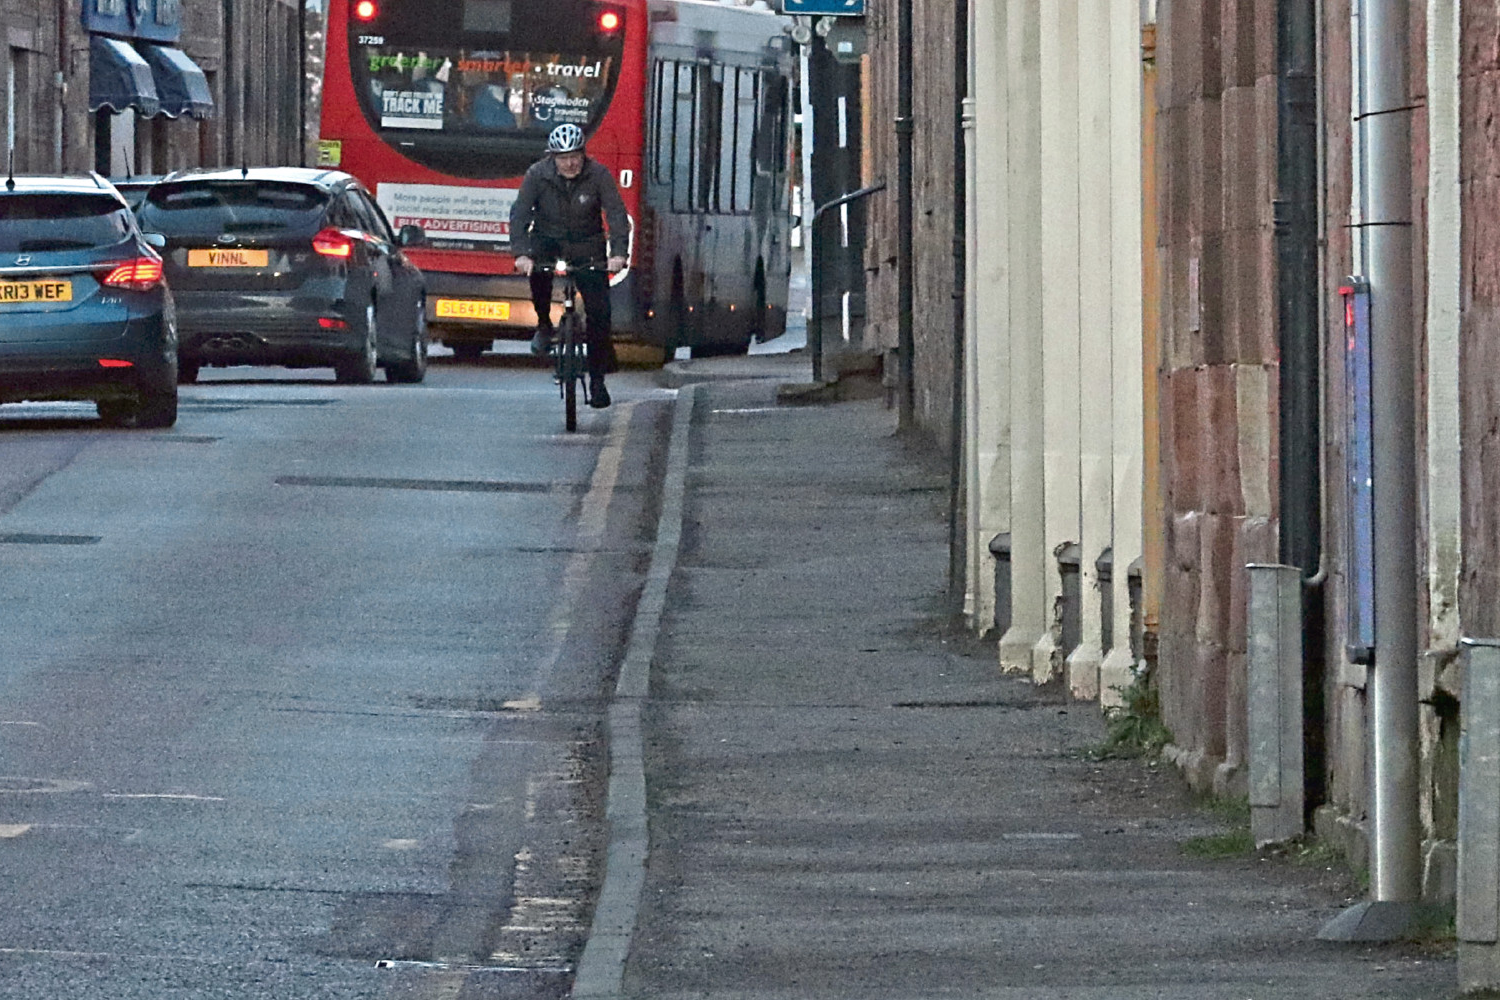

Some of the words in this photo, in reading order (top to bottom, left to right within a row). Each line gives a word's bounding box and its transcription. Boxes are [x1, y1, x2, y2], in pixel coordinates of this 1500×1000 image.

[547, 61, 601, 78] travel
[383, 96, 421, 113] TRACK
[423, 97, 443, 114] ME
[423, 219, 501, 233] ADVERTISING
[34, 283, 65, 299] WEF
